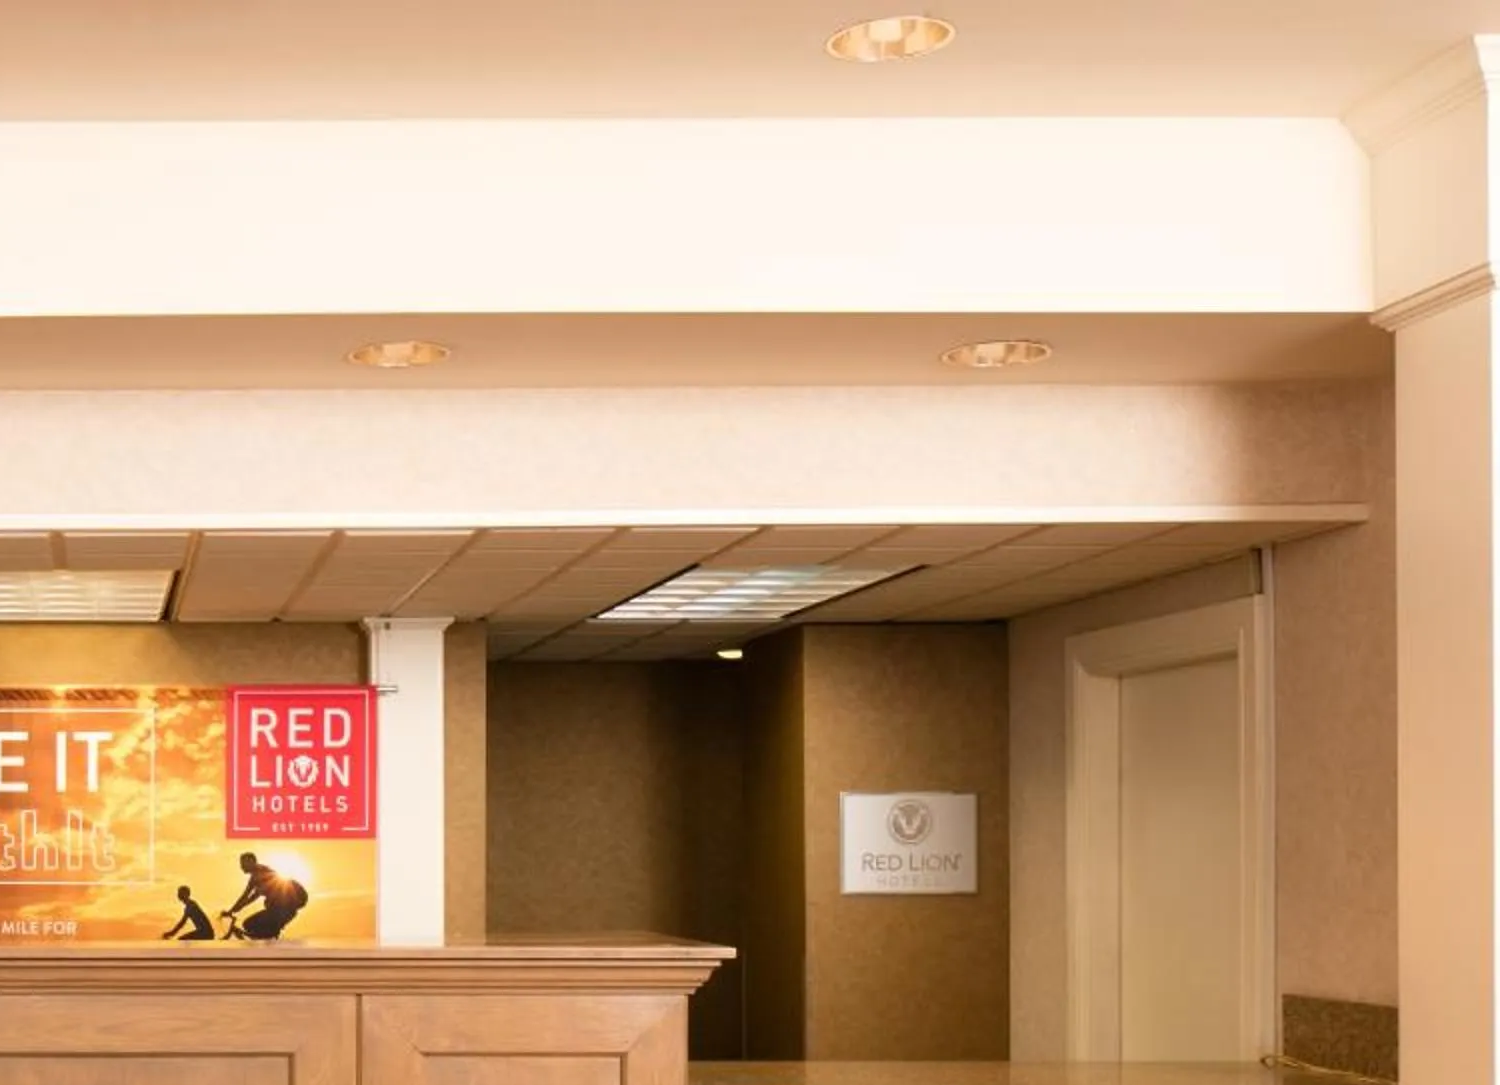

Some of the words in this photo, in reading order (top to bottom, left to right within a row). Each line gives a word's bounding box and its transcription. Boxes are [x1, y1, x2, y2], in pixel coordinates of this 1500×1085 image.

[250, 707, 351, 748] RED
[56, 731, 113, 792] IT
[250, 755, 350, 788] LION
[252, 795, 348, 813] HOTELS
[861, 852, 903, 872] RED
[909, 852, 960, 872] LION
[1, 920, 39, 936] MILE
[43, 920, 78, 936] FOR
